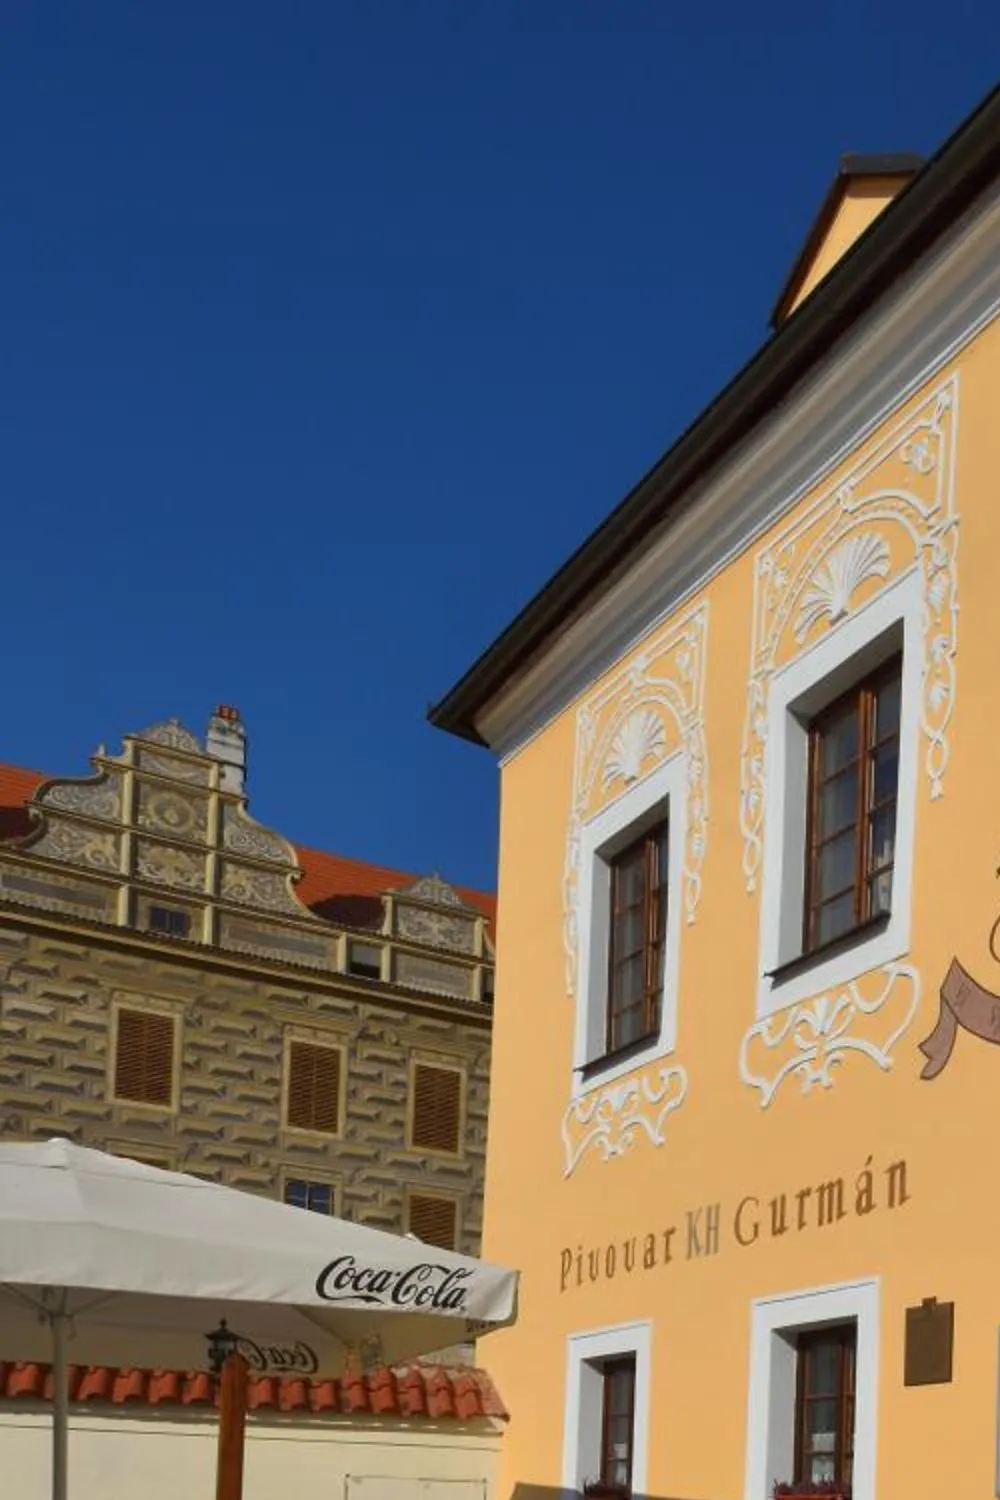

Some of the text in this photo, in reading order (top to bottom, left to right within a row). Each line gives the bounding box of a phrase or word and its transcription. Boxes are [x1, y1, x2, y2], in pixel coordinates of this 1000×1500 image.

[559, 1155, 912, 1293] Pivovar KH Gurmán
